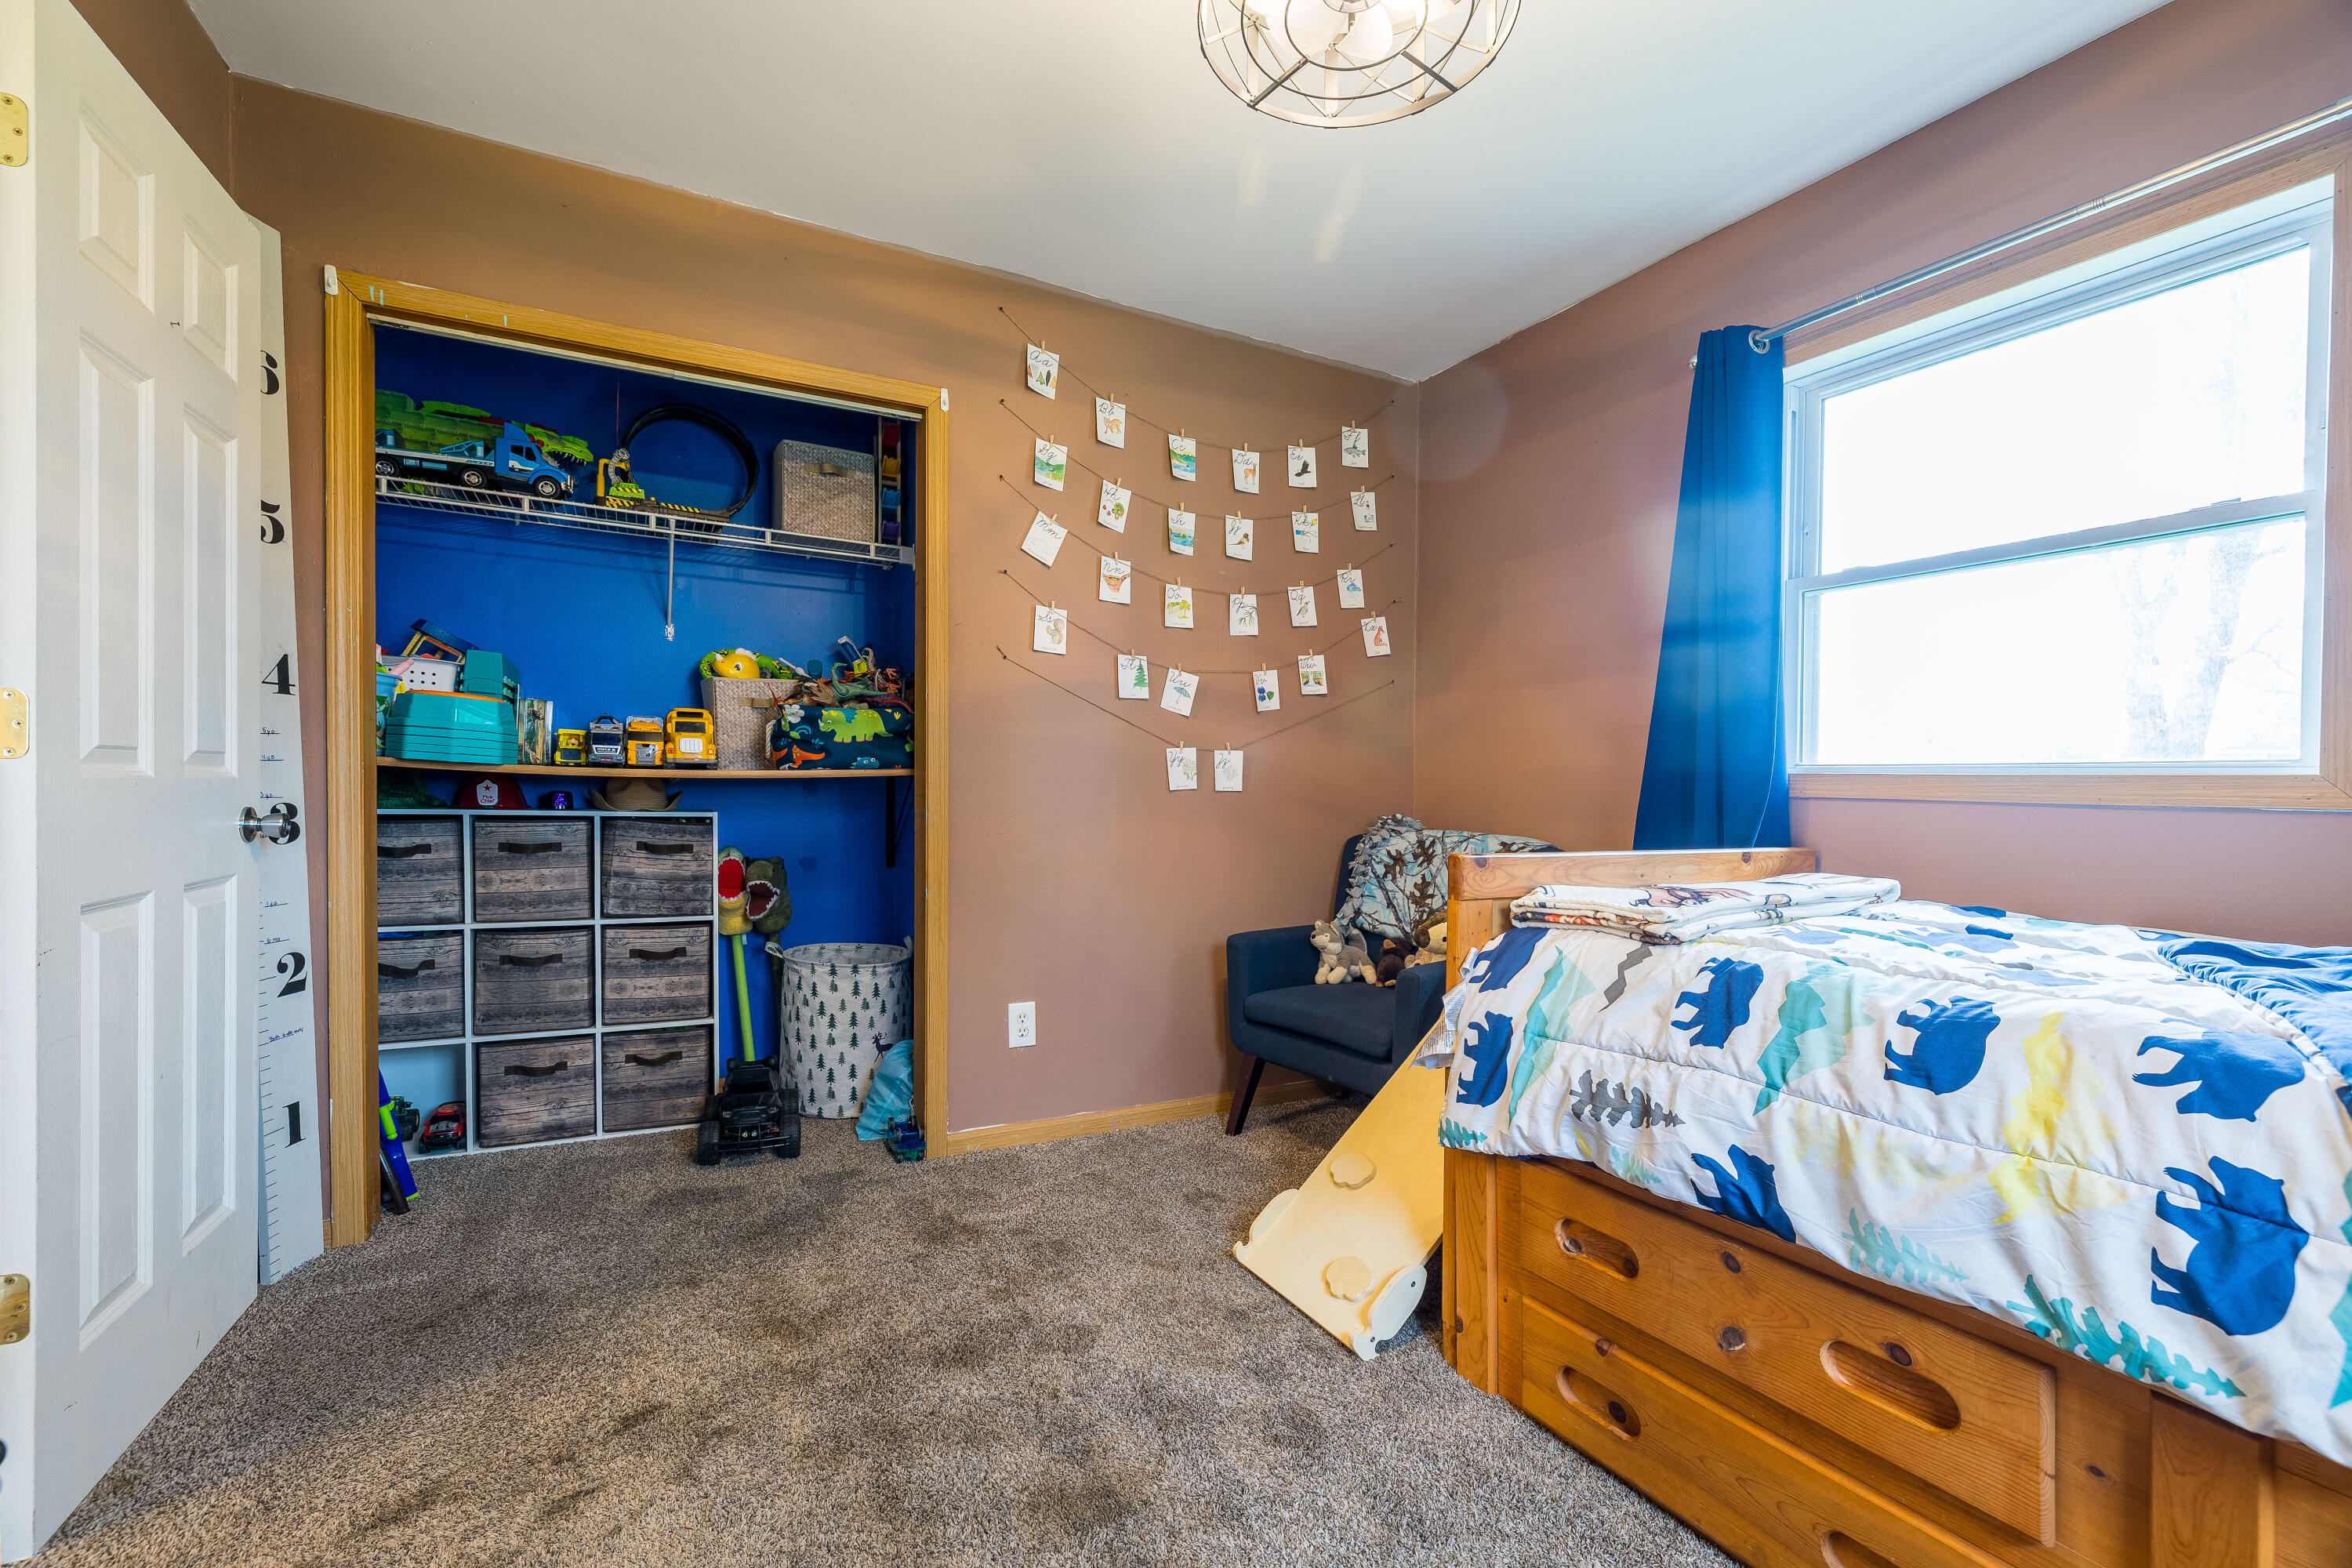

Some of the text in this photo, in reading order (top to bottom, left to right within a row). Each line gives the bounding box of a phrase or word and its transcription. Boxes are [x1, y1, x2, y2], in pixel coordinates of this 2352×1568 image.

[1029, 350, 1054, 368] Aa
[1171, 438, 1186, 452] Cc
[1233, 452, 1253, 466] Dd
[260, 499, 285, 544] 5
[1167, 587, 1182, 600] Oo
[261, 653, 296, 696] 4
[269, 802, 301, 845] 3
[277, 952, 308, 998] 2
[282, 1101, 307, 1149] 1
